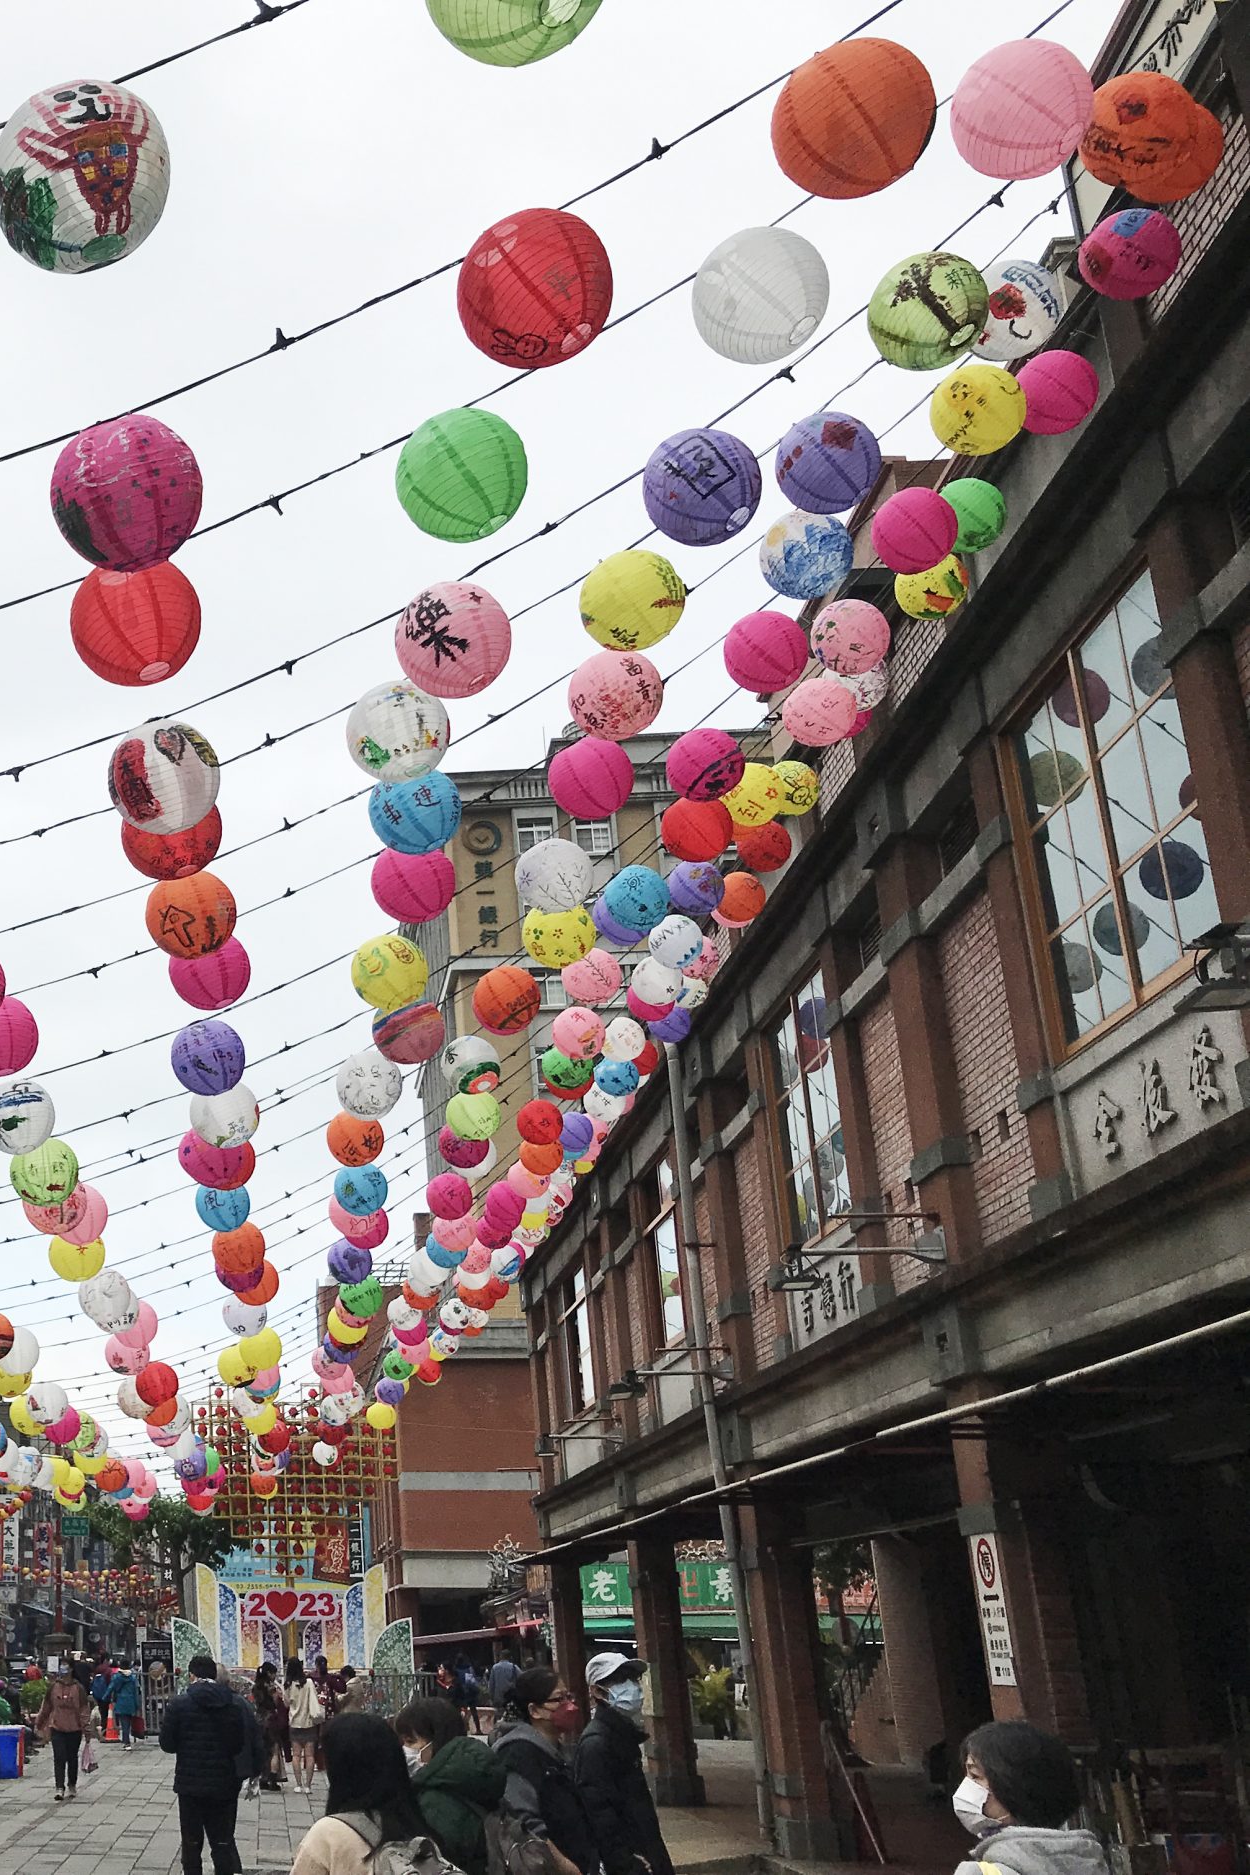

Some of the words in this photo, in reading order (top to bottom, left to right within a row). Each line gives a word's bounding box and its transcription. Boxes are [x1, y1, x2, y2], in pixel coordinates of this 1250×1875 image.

[474, 860, 499, 949] 第一銀行
[588, 1569, 618, 1602] 老
